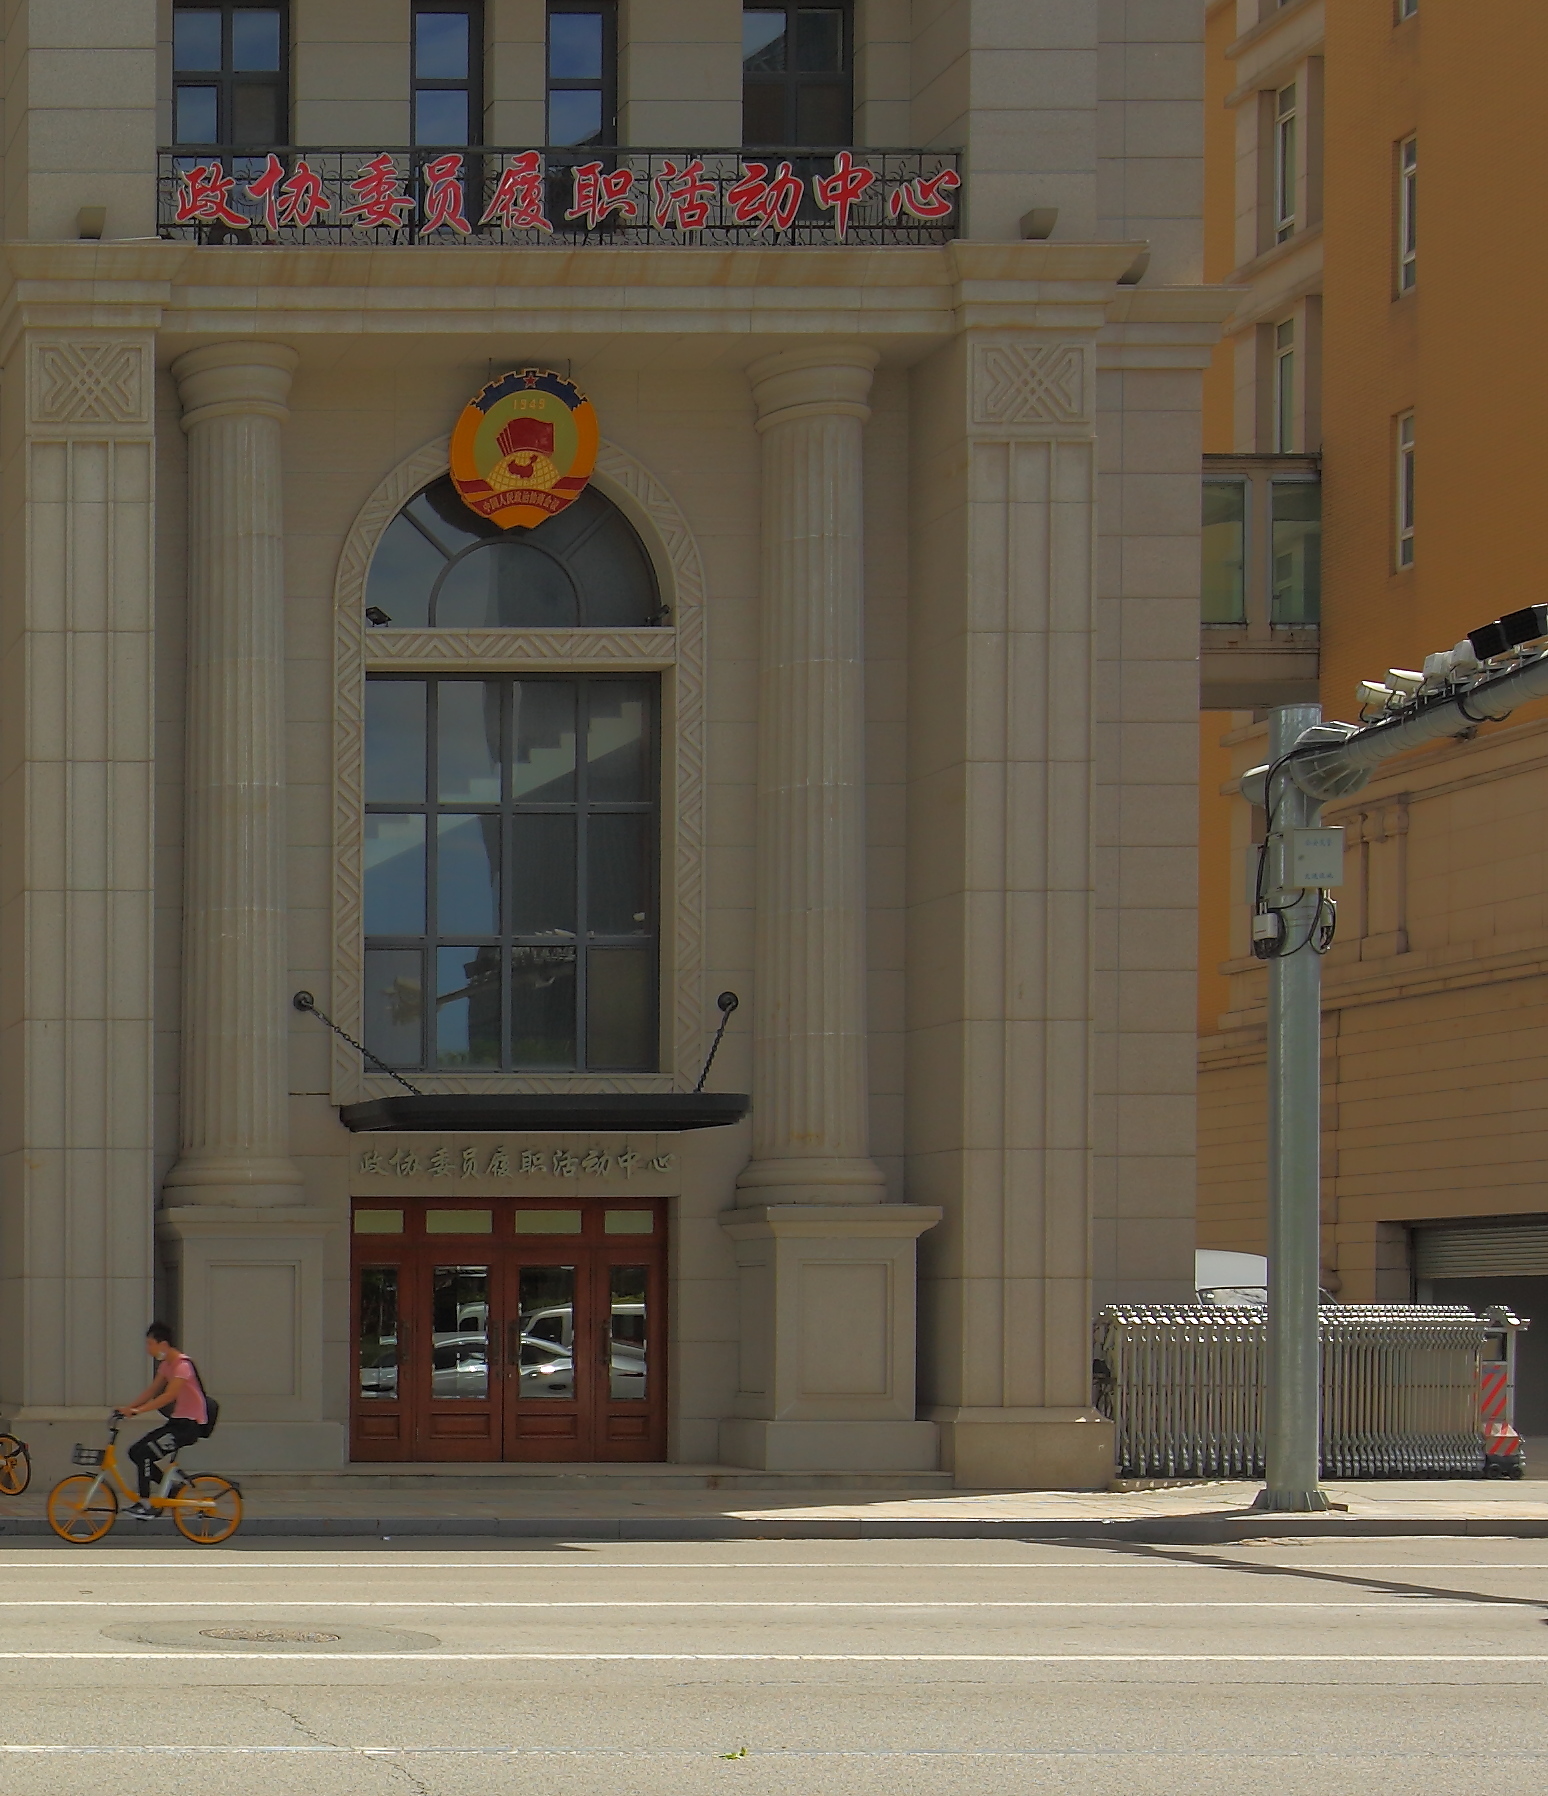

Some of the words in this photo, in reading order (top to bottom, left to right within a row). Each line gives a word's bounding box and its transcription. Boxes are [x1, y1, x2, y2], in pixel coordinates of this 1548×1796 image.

[173, 150, 961, 238] 政协委员履职活动中心
[512, 398, 546, 410] 1949
[358, 1146, 677, 1180] 政协委员履职活动中心
